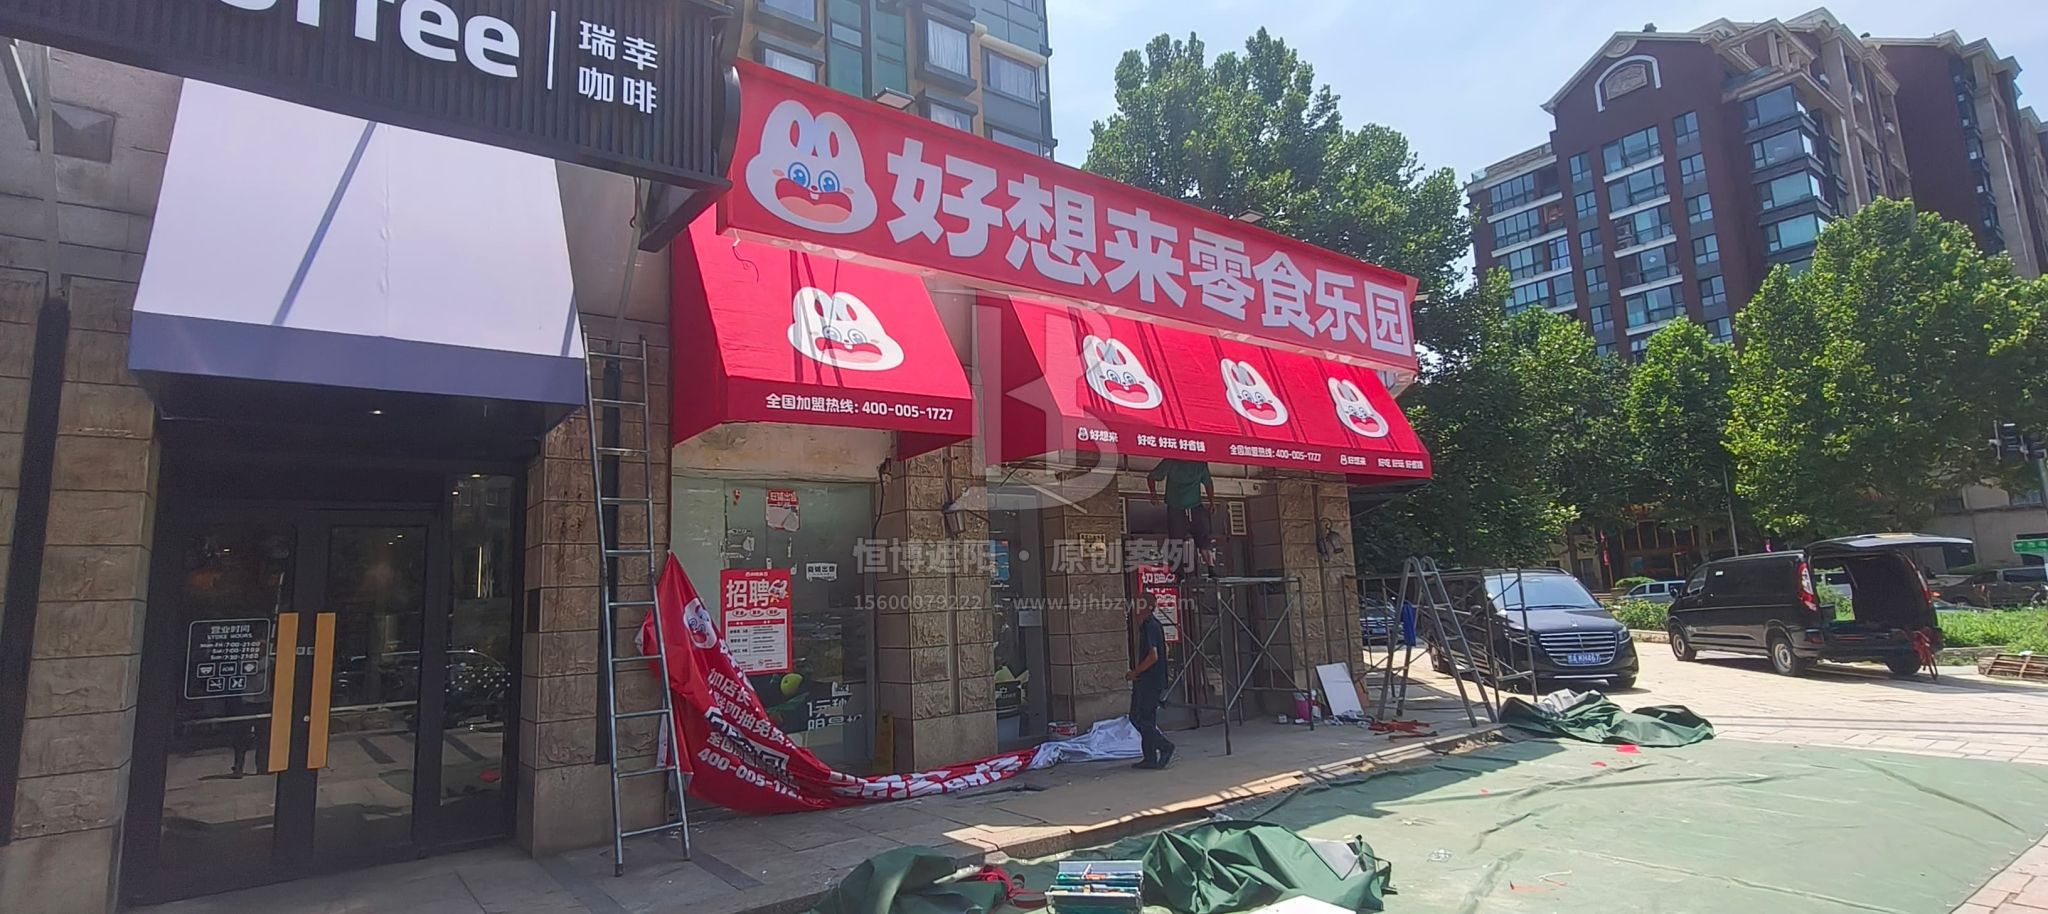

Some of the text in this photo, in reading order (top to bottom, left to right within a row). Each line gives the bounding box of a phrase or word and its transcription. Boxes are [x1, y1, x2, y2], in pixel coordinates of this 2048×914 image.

[579, 20, 659, 71] 瑞幸
[578, 66, 658, 114] 咖啡
[886, 137, 1413, 357] 好想来零食乐园
[861, 402, 954, 421] 400-005-1727
[1089, 430, 1119, 443] 好想来
[1137, 434, 1157, 447] 好吃
[1158, 437, 1178, 449] 好玩
[726, 579, 770, 608] 招聘
